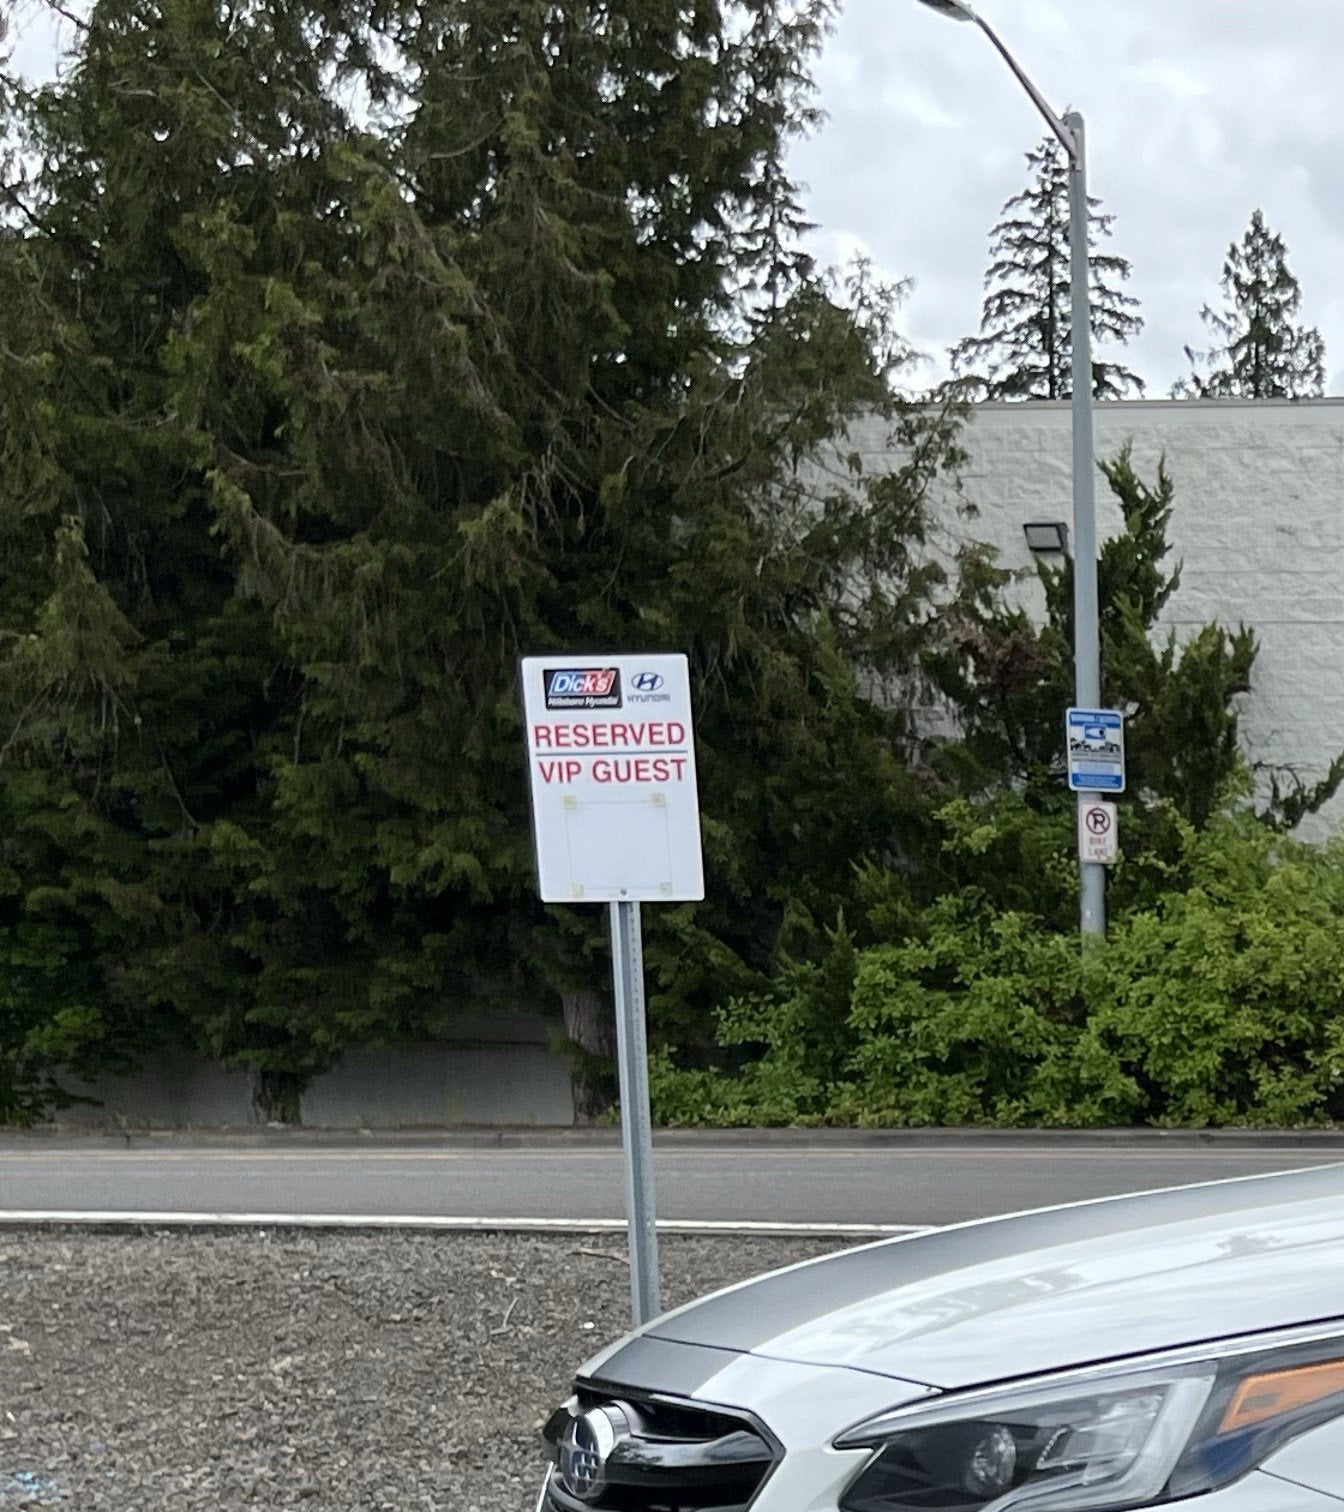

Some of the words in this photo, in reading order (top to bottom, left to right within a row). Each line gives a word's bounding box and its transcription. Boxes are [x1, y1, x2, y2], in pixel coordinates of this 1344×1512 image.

[534, 722, 686, 748] RESERVED
[538, 761, 582, 784] VIP
[592, 758, 687, 783] GUEST
